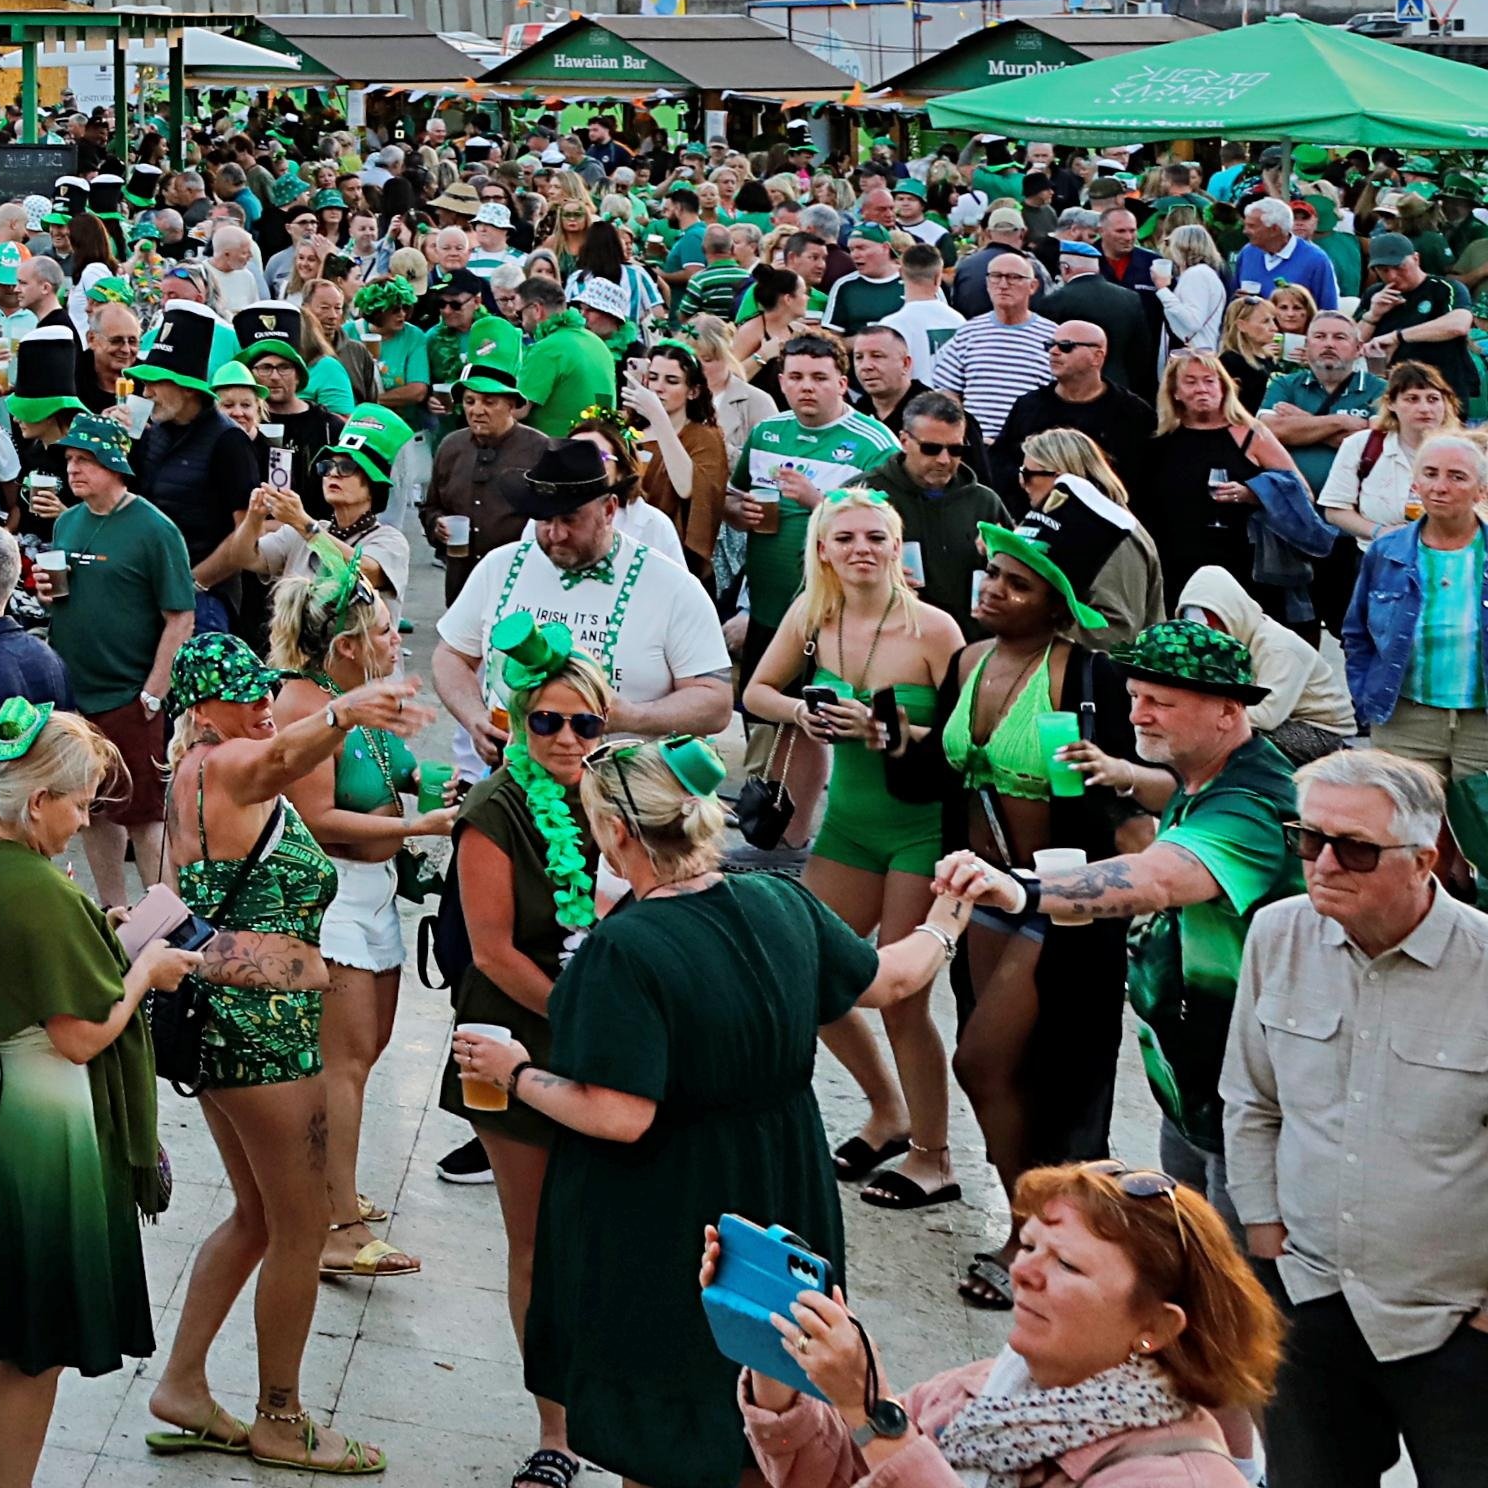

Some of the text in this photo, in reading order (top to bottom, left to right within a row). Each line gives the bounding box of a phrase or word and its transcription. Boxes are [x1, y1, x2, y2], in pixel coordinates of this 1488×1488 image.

[553, 54, 648, 69] Hawaiian Bar
[536, 607, 568, 624] IRISH
[574, 612, 599, 626] IT'S
